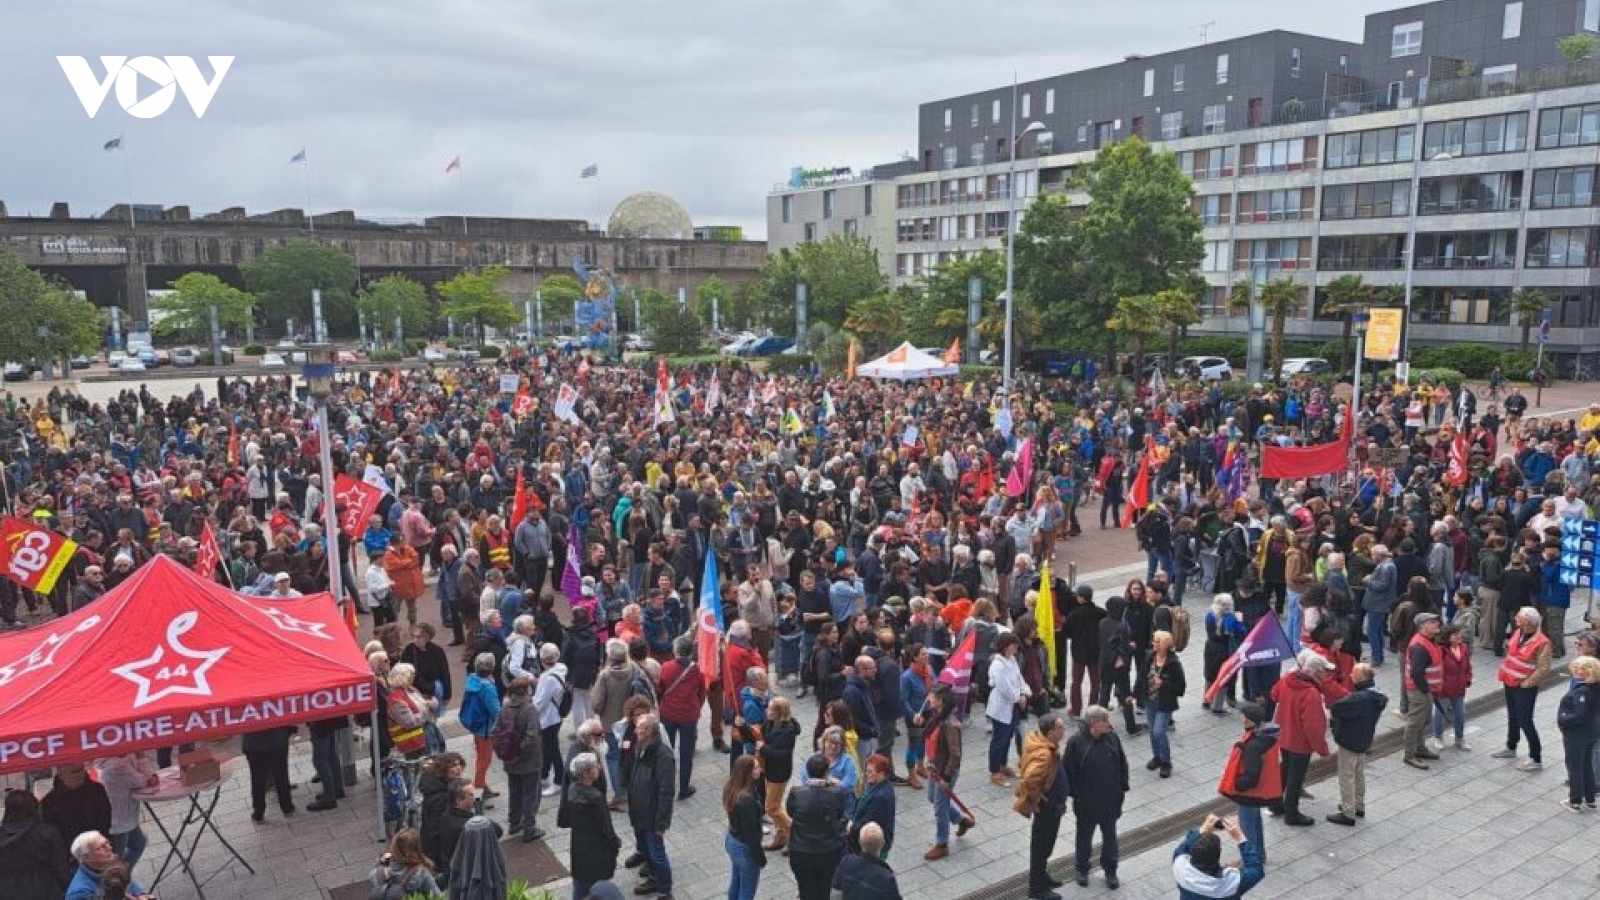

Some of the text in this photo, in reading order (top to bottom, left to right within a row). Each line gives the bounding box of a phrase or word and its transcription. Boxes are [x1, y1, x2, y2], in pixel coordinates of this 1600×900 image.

[155, 663, 189, 680] 44
[0, 682, 373, 764] PCF LOIRE-ATLANTIQUE
